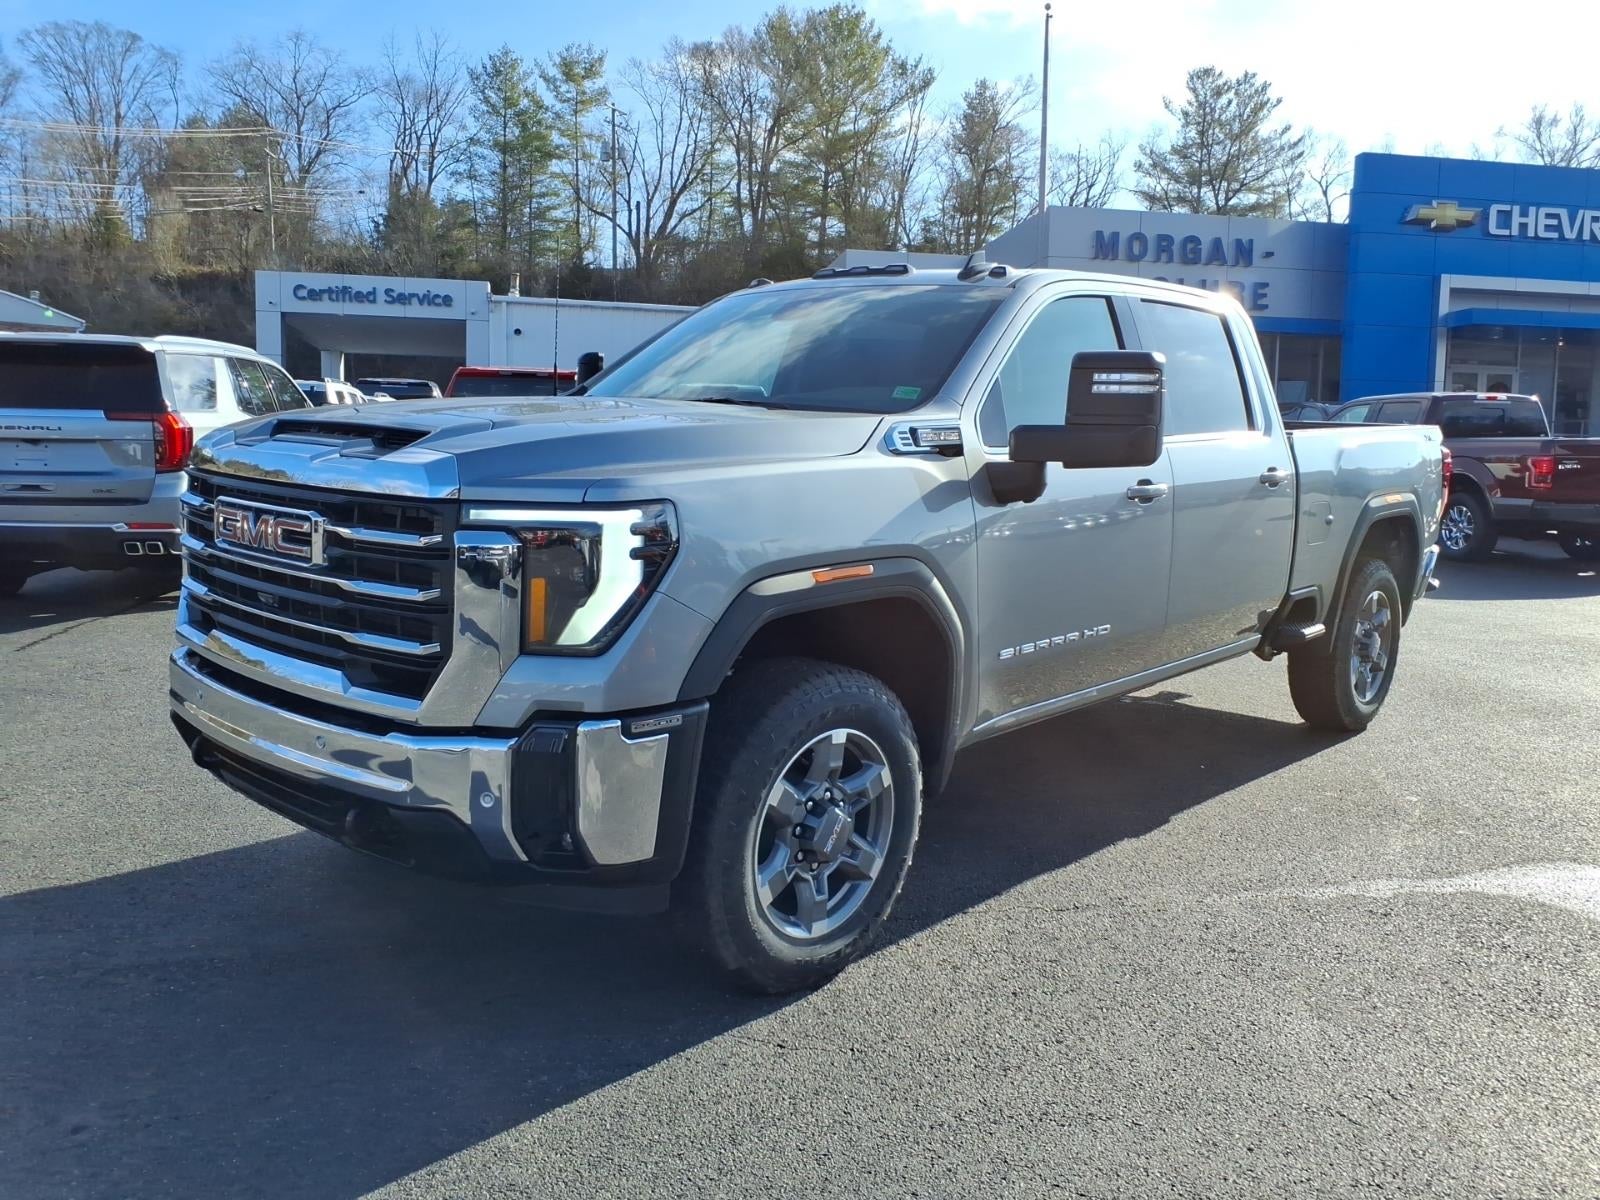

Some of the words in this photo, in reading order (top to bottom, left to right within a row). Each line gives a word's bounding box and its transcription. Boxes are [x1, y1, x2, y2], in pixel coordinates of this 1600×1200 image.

[293, 284, 377, 304] Certified
[384, 288, 453, 307] Service
[215, 506, 312, 558] GMC
[999, 632, 1080, 660] SIERRA
[1082, 624, 1111, 640] HD
